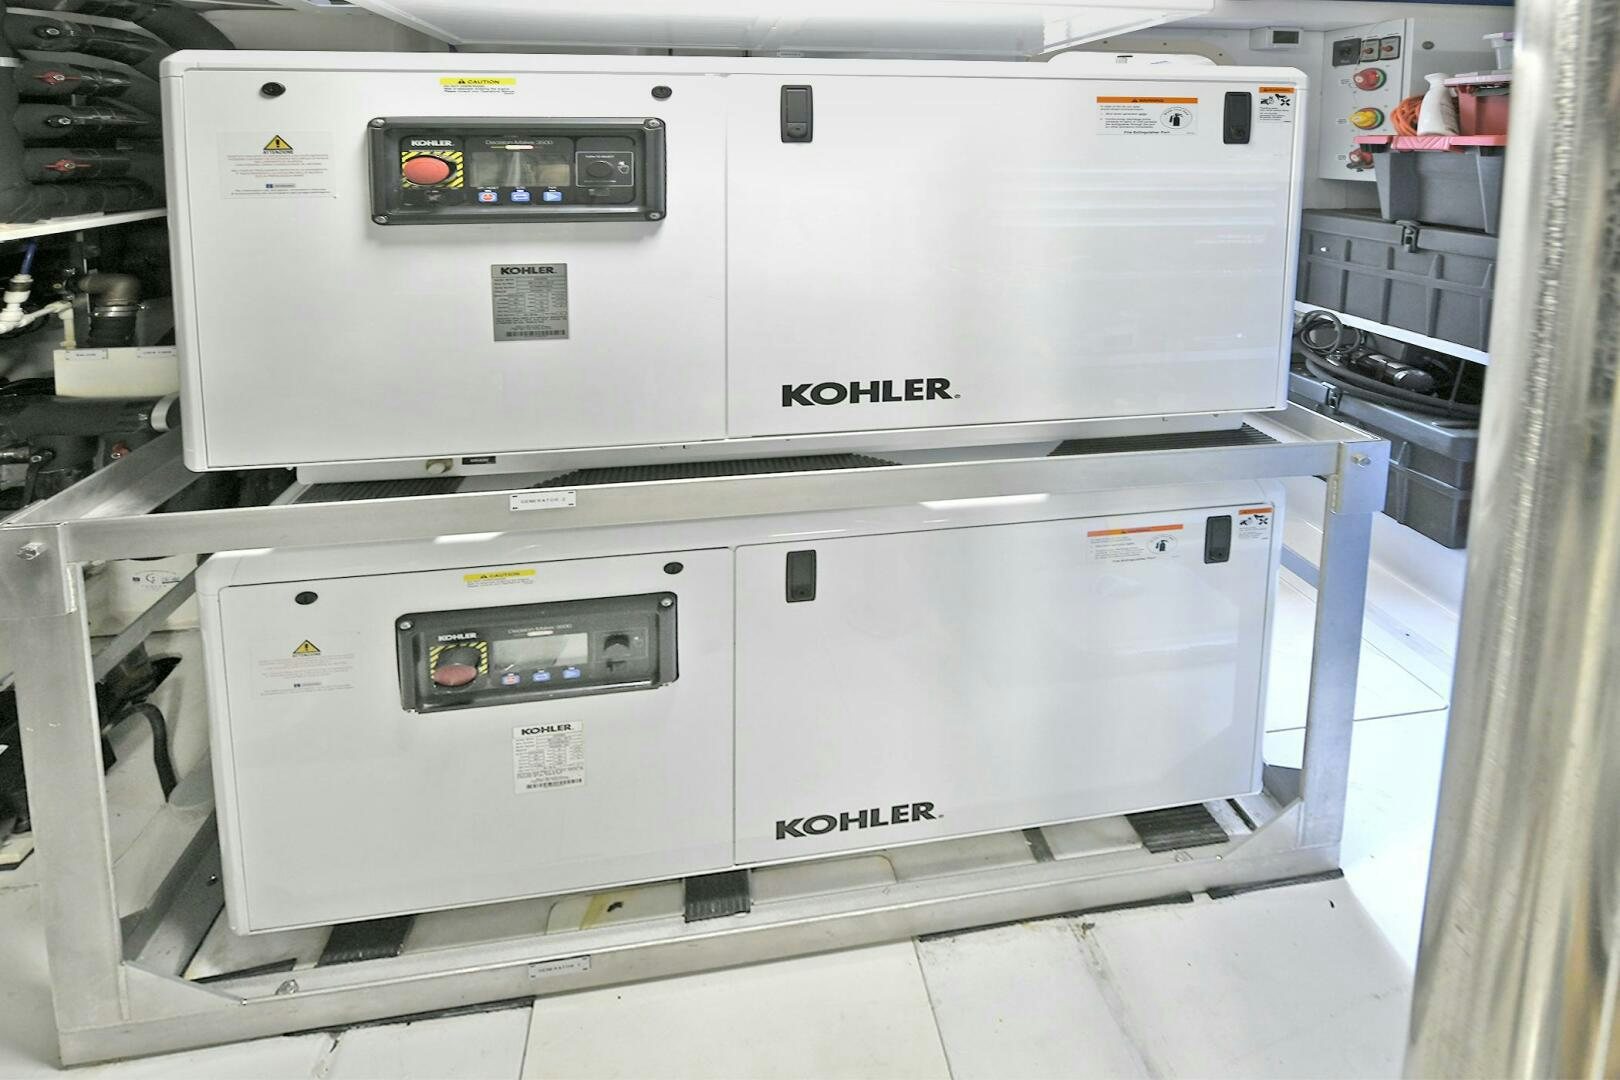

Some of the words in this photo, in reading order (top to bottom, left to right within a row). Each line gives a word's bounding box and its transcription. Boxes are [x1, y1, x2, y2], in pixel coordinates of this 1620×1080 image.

[411, 139, 454, 147] KOHLER
[500, 266, 556, 275] KOHLER
[782, 377, 955, 407] KOHLER
[438, 632, 478, 642] KOHLER
[521, 723, 573, 735] KOHLER
[776, 801, 939, 840] KOHLER
